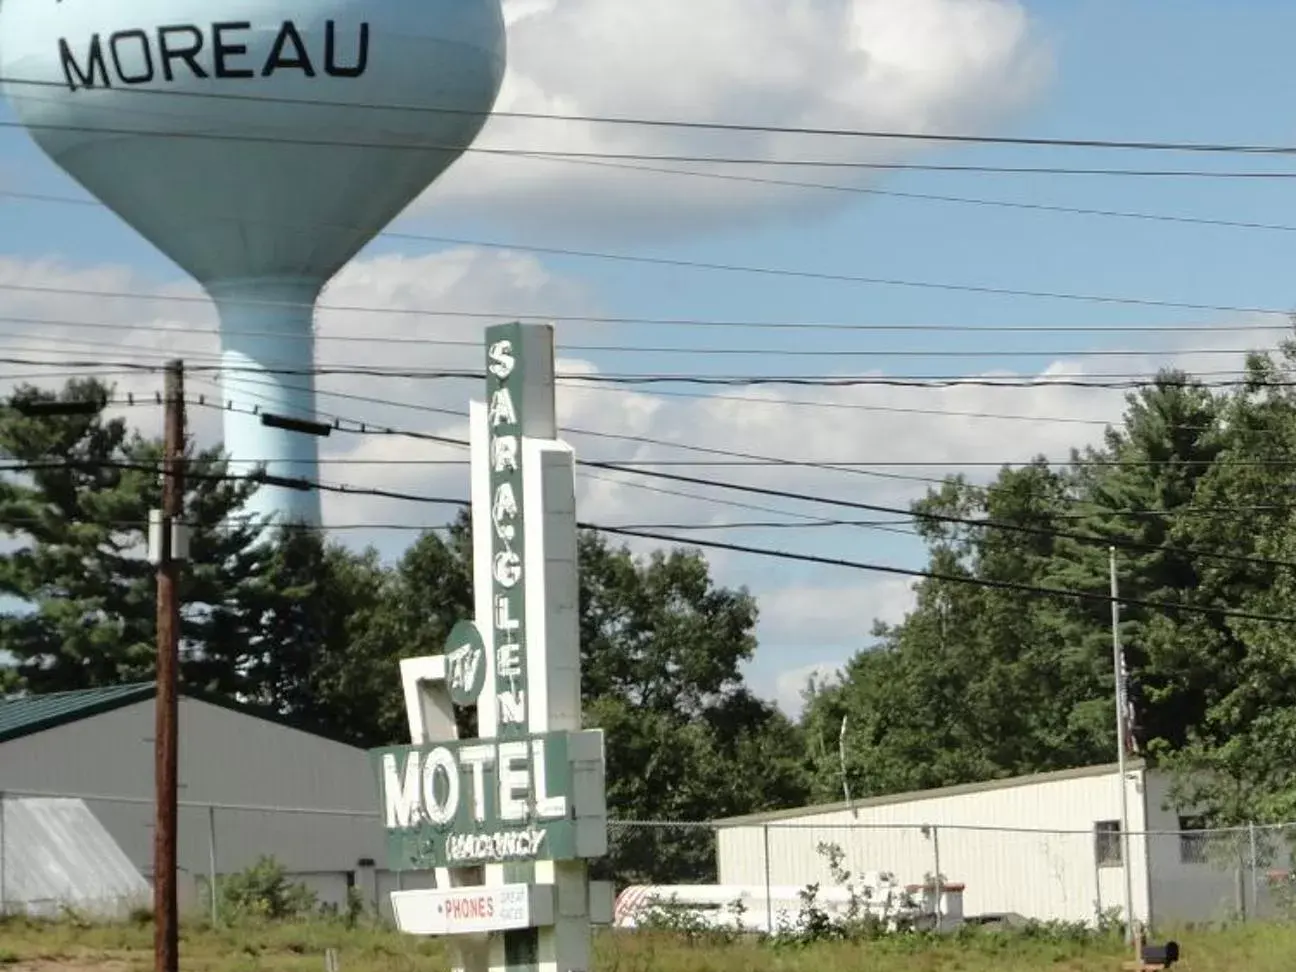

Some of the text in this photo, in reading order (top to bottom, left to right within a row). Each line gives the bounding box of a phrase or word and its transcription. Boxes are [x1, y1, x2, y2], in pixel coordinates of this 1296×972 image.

[58, 19, 370, 92] MOREAU
[448, 643, 482, 693] TV
[382, 738, 567, 830] MOTEL
[446, 829, 547, 861] VACANCY
[444, 896, 495, 920] PHONES
